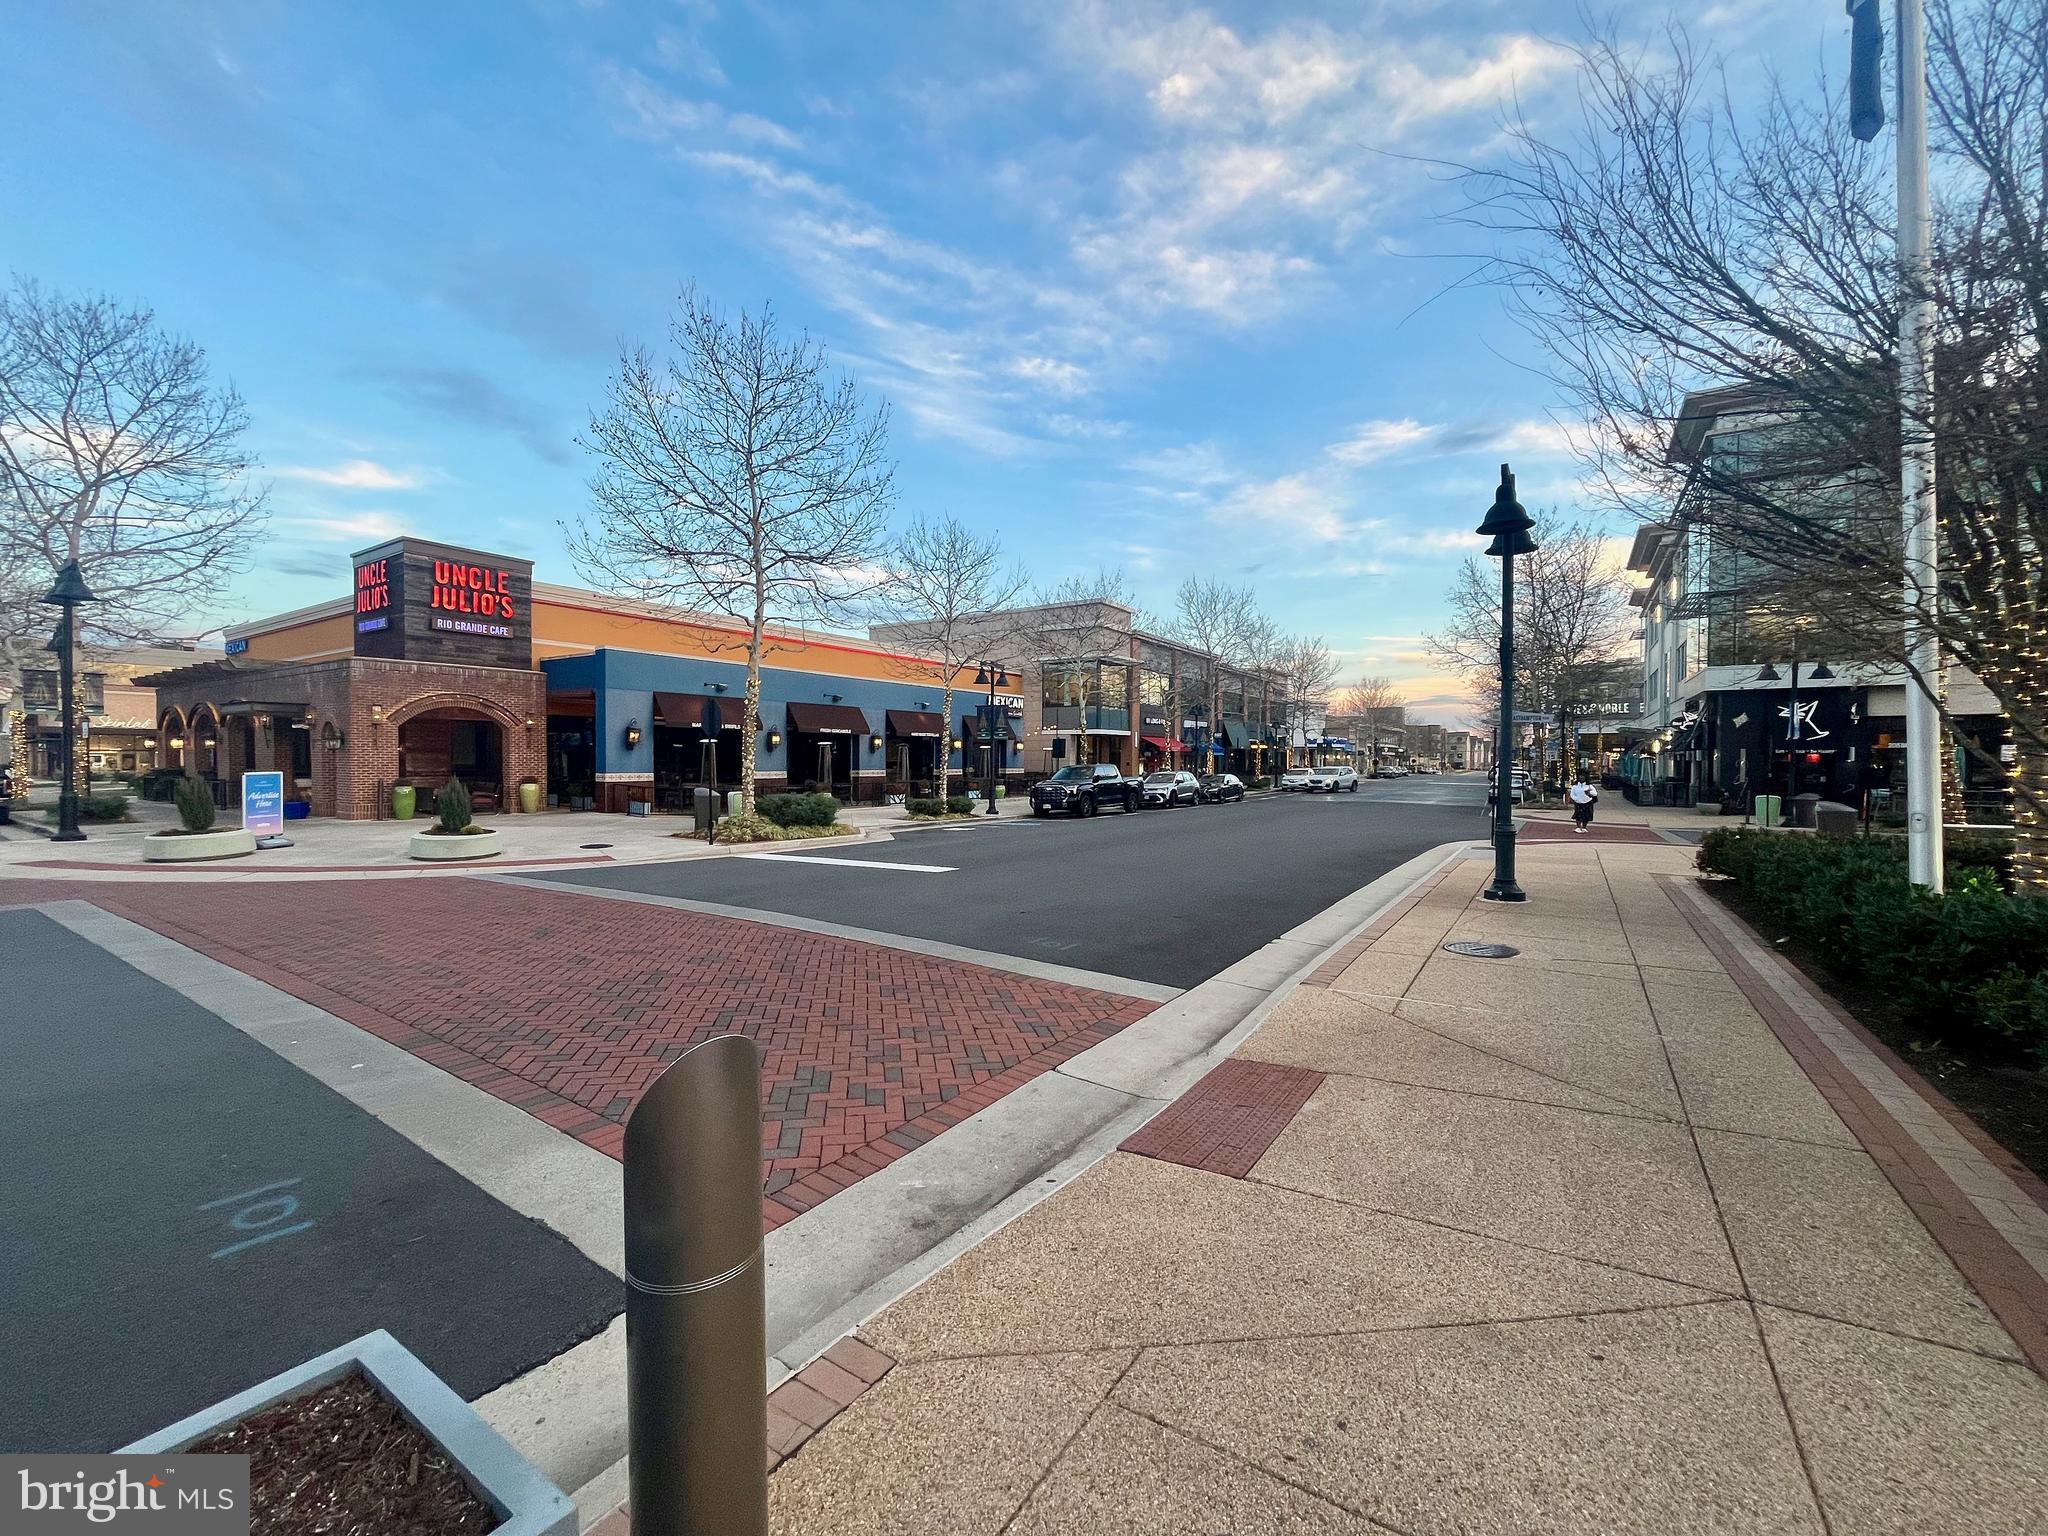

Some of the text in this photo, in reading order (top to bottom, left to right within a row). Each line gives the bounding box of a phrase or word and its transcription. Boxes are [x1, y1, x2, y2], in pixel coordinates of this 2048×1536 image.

[358, 560, 387, 589] UNCLE
[434, 560, 510, 594] UNCLE
[357, 585, 389, 614] JULIO'S
[430, 585, 515, 619] JULIO'S
[437, 618, 509, 637] RIO GRANDE CAFE
